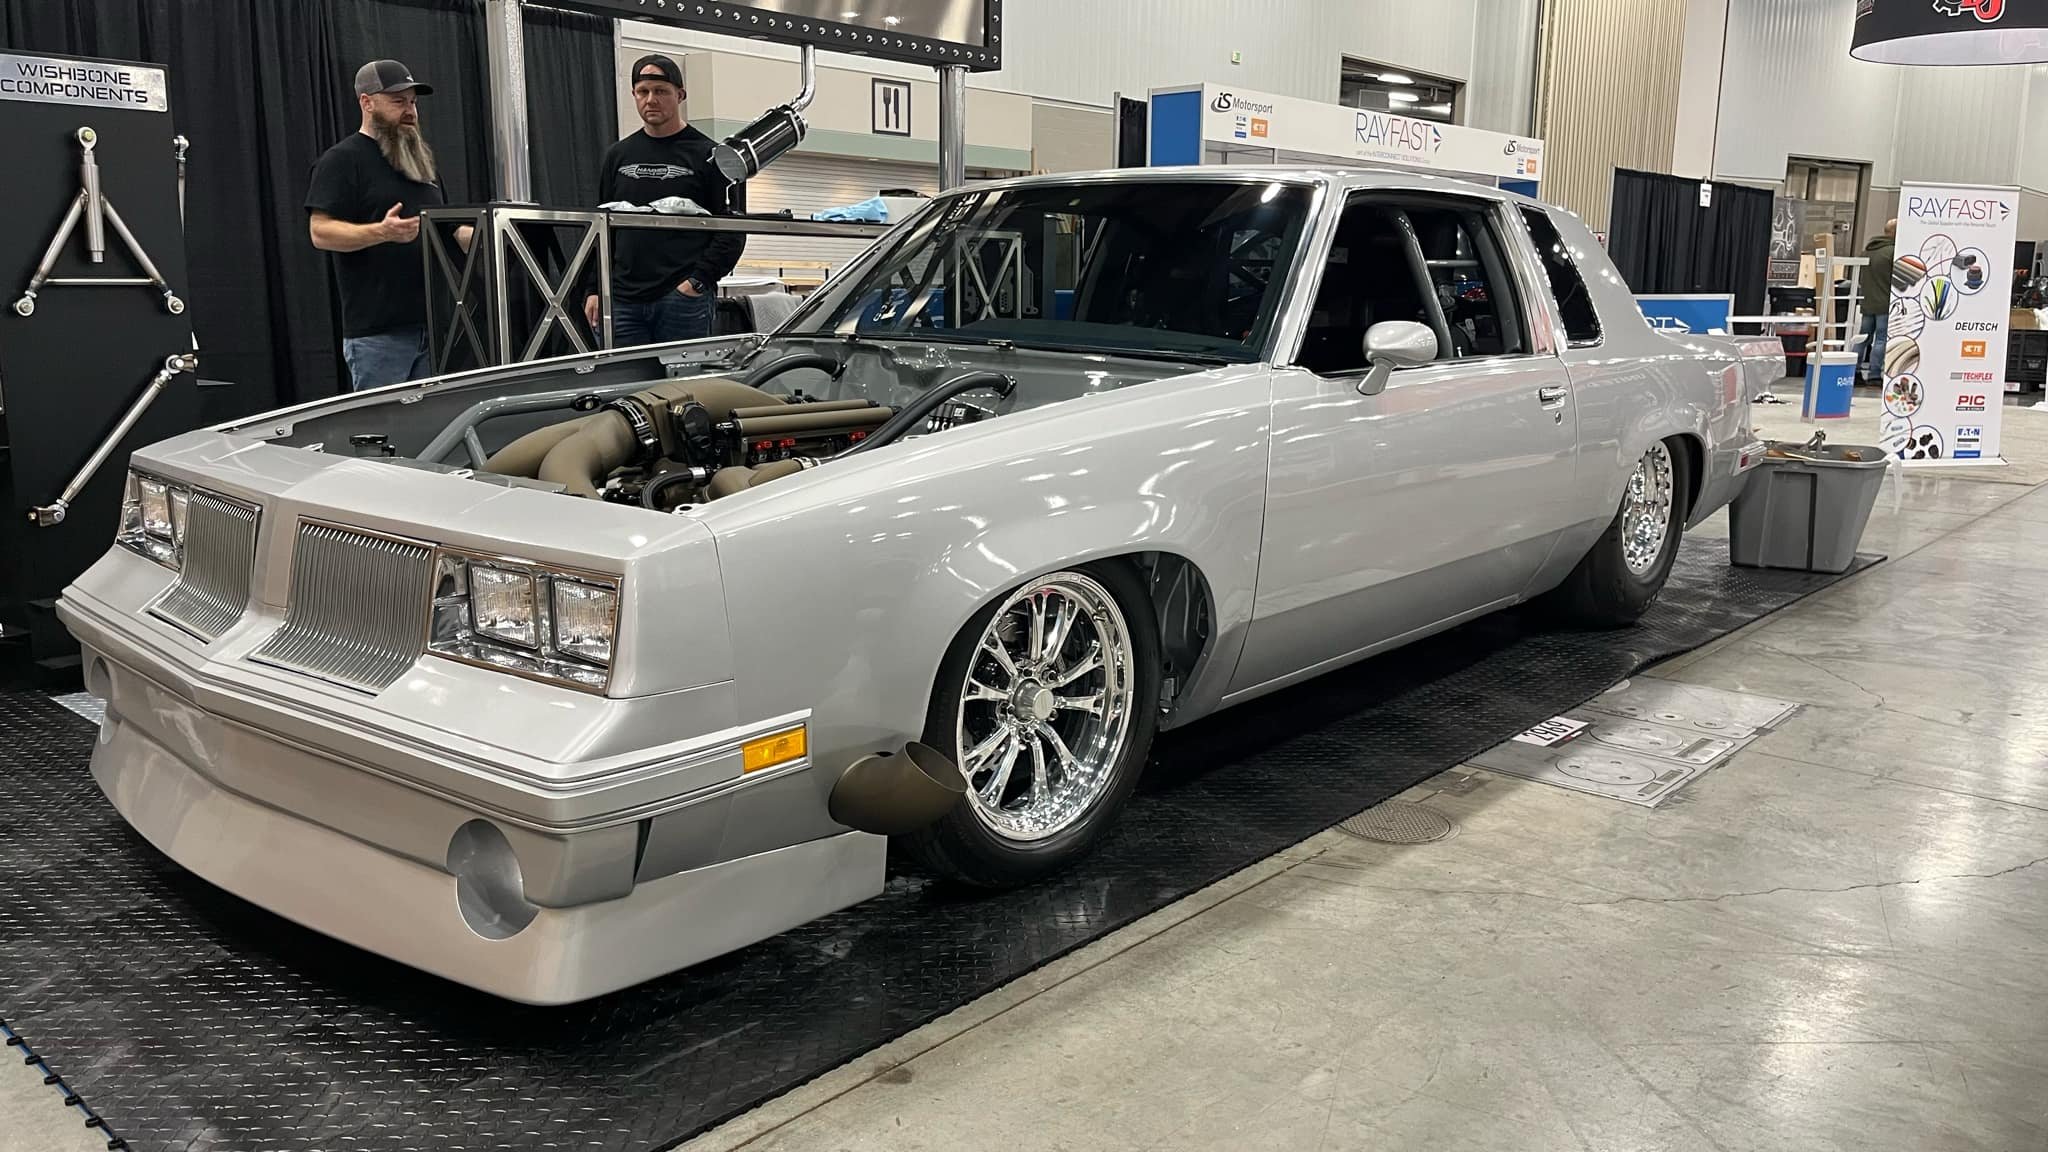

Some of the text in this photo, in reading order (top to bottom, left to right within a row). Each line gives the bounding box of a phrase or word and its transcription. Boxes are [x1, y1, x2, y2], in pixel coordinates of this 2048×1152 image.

[17, 63, 131, 86] WISHBONE
[1, 79, 148, 103] COMPONENTS
[1233, 97, 1273, 114] Motorsport
[1356, 112, 1432, 152] RAYFAST
[1908, 197, 1997, 219] RAYFAST
[1955, 321, 1998, 331] DEUTSCH
[1963, 372, 1993, 380] TECHFLEX
[1958, 395, 1985, 406] PIC
[1521, 720, 1574, 741] 2969
